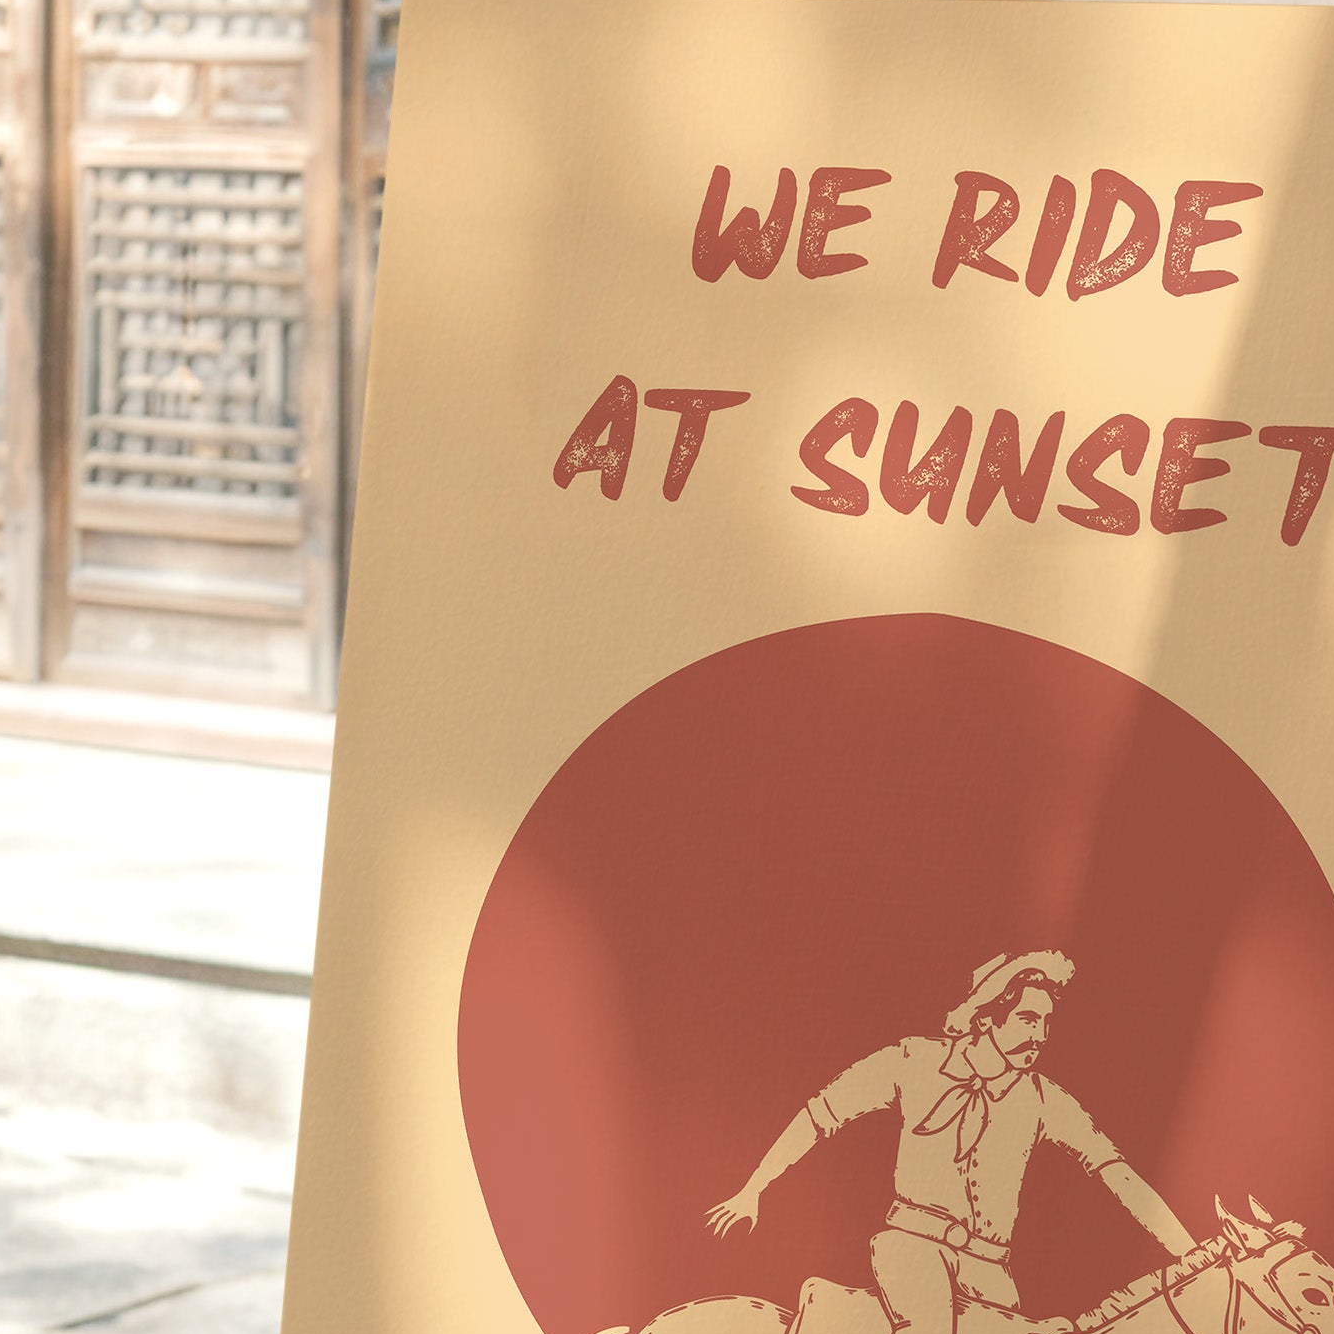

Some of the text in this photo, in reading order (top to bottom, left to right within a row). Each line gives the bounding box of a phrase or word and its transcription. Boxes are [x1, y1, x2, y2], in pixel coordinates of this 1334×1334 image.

[691, 165, 1264, 302] WE RIDE
[553, 375, 751, 502] AT
